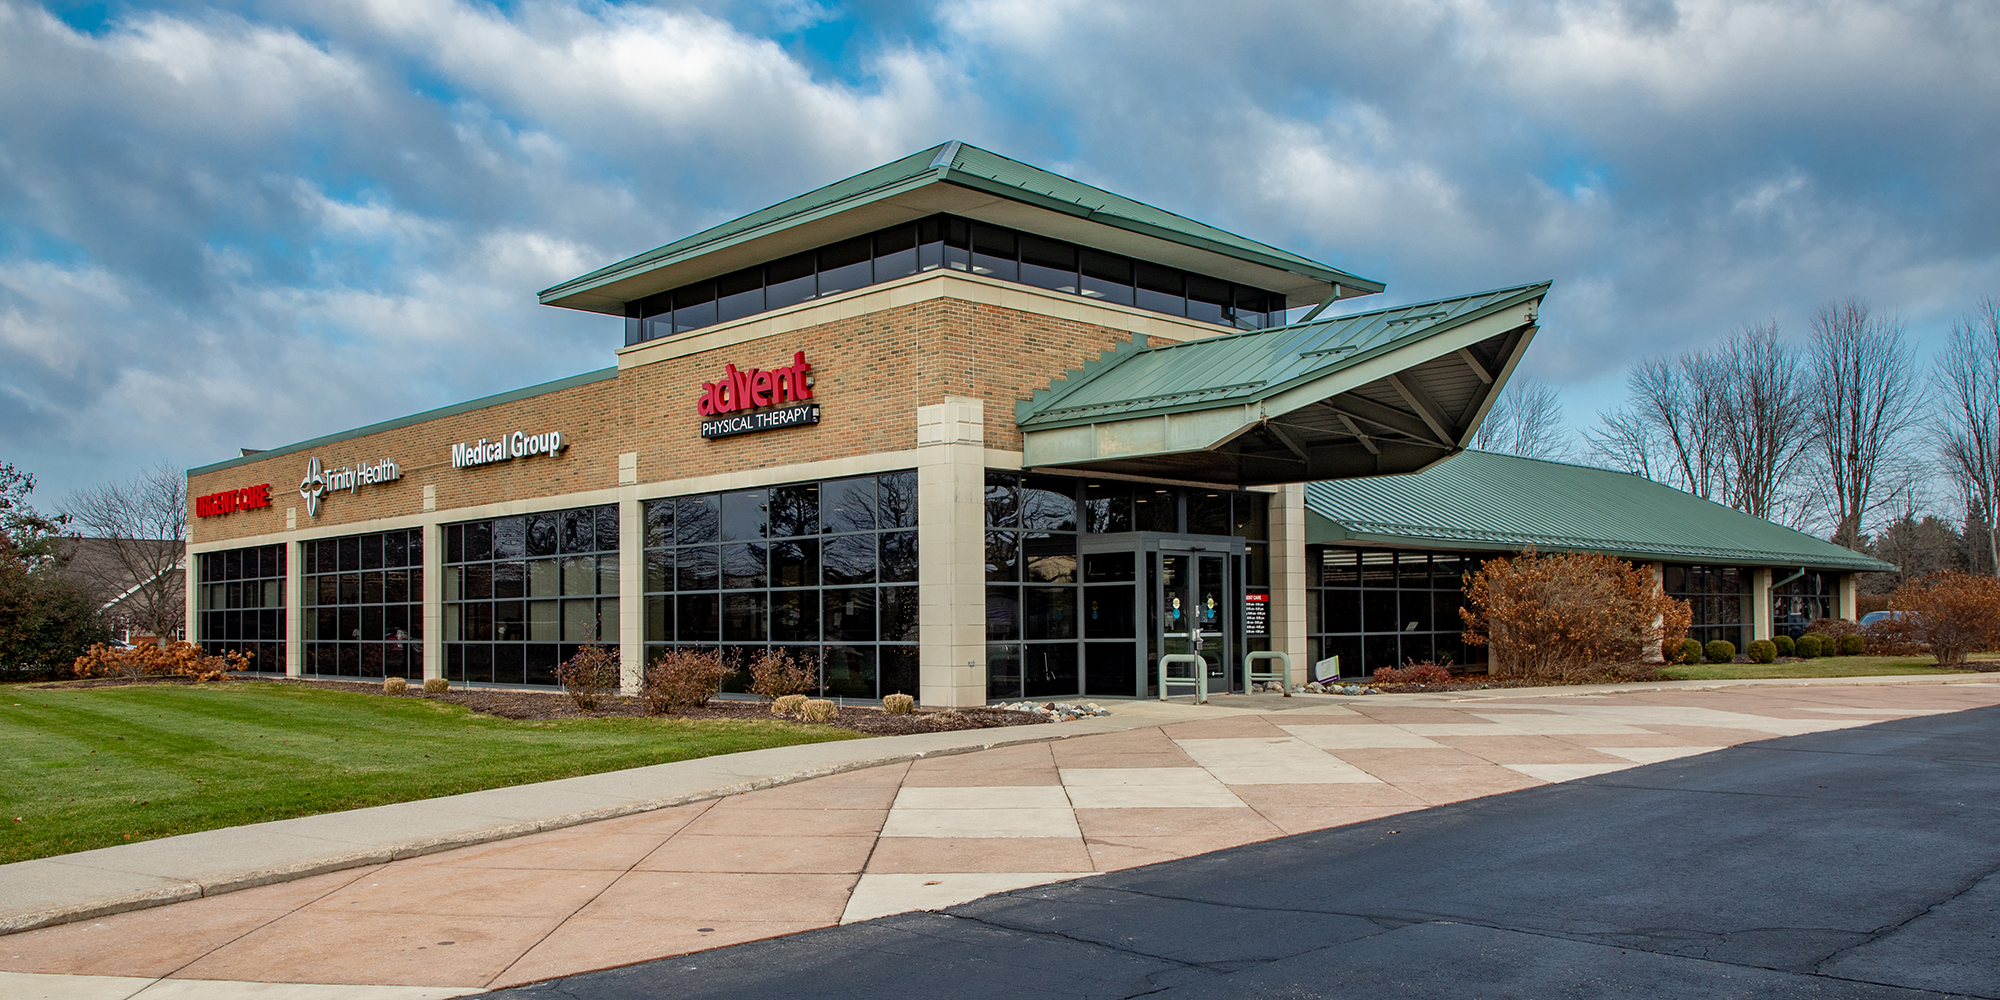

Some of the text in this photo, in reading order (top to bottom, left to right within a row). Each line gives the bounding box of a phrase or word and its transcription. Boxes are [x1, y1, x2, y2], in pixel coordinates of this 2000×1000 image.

[697, 350, 812, 416] advent
[702, 406, 809, 436] PHYSICAL THERAPY
[452, 430, 561, 468] Medical Group
[324, 457, 396, 494] Trinity Health
[196, 483, 270, 518] URGENT CARE
